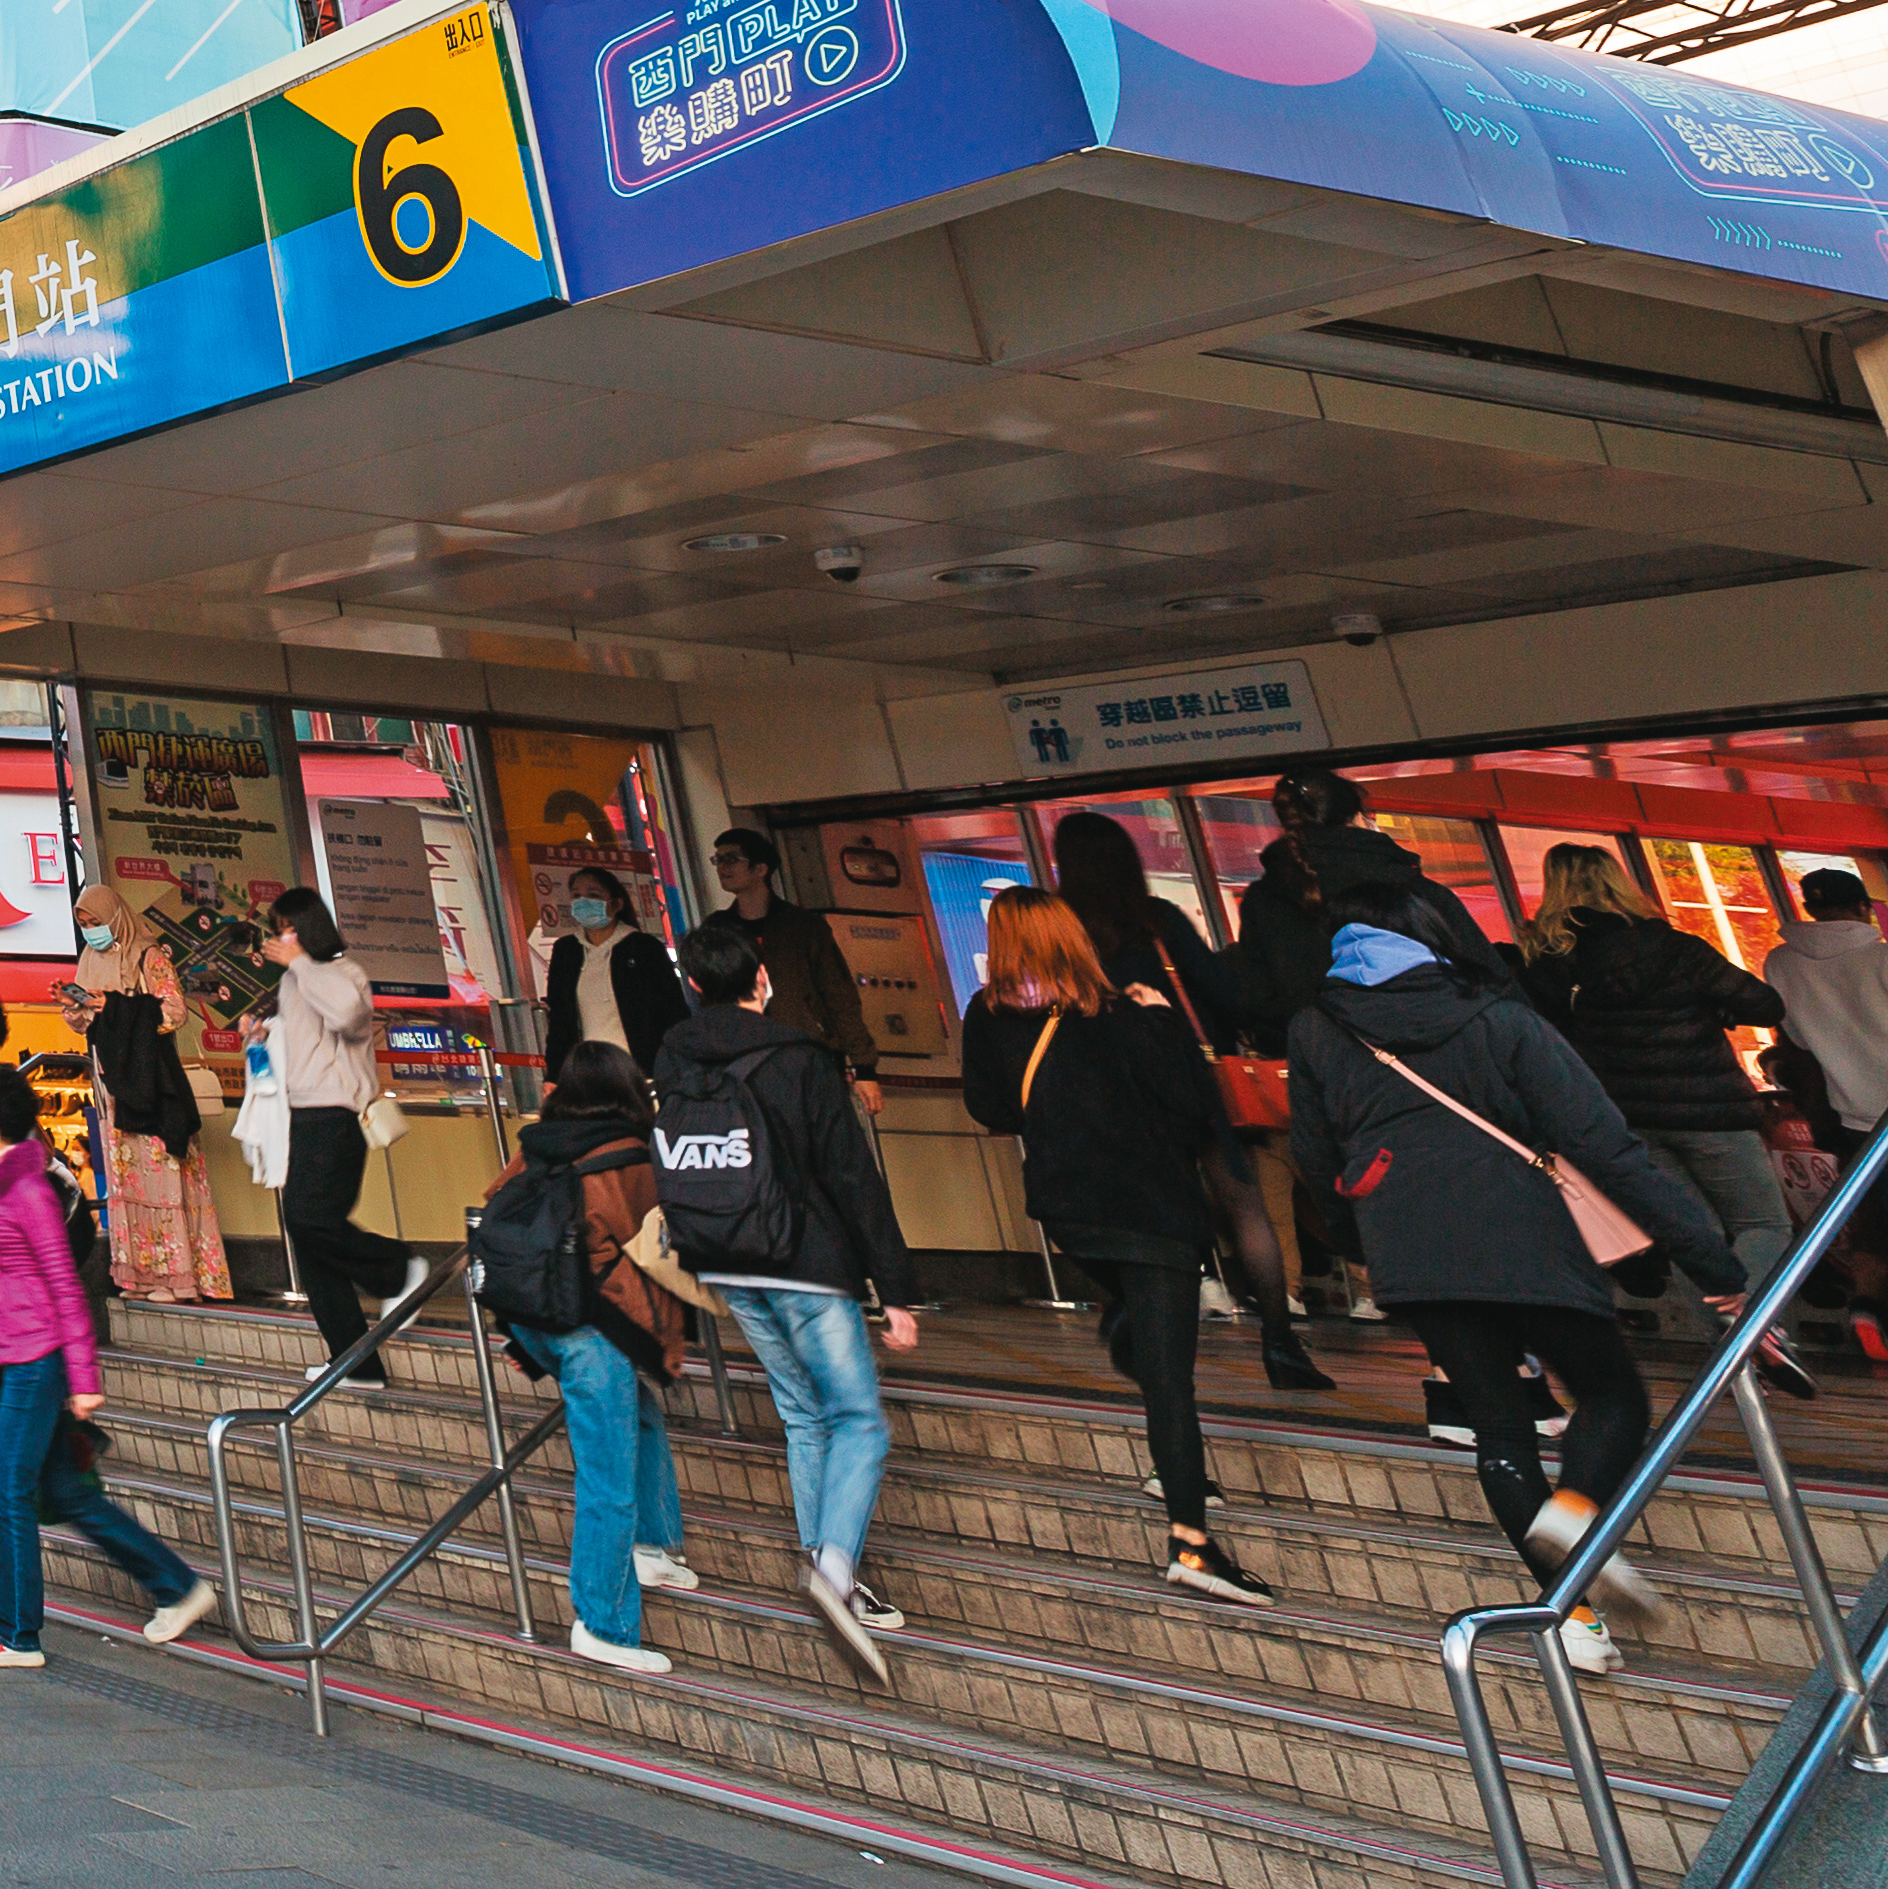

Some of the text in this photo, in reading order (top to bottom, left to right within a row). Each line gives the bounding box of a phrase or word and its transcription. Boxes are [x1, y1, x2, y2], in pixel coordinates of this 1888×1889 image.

[444, 12, 483, 51] 出入口
[628, 23, 726, 108] 西門
[355, 106, 468, 287] 6
[1024, 696, 1061, 710] metro
[1097, 682, 1291, 727] 穿越區禁止逗留
[1106, 720, 1302, 750] Do not block the passageway
[389, 1032, 442, 1049] UMBRELLA
[653, 1127, 752, 1170] VANS
